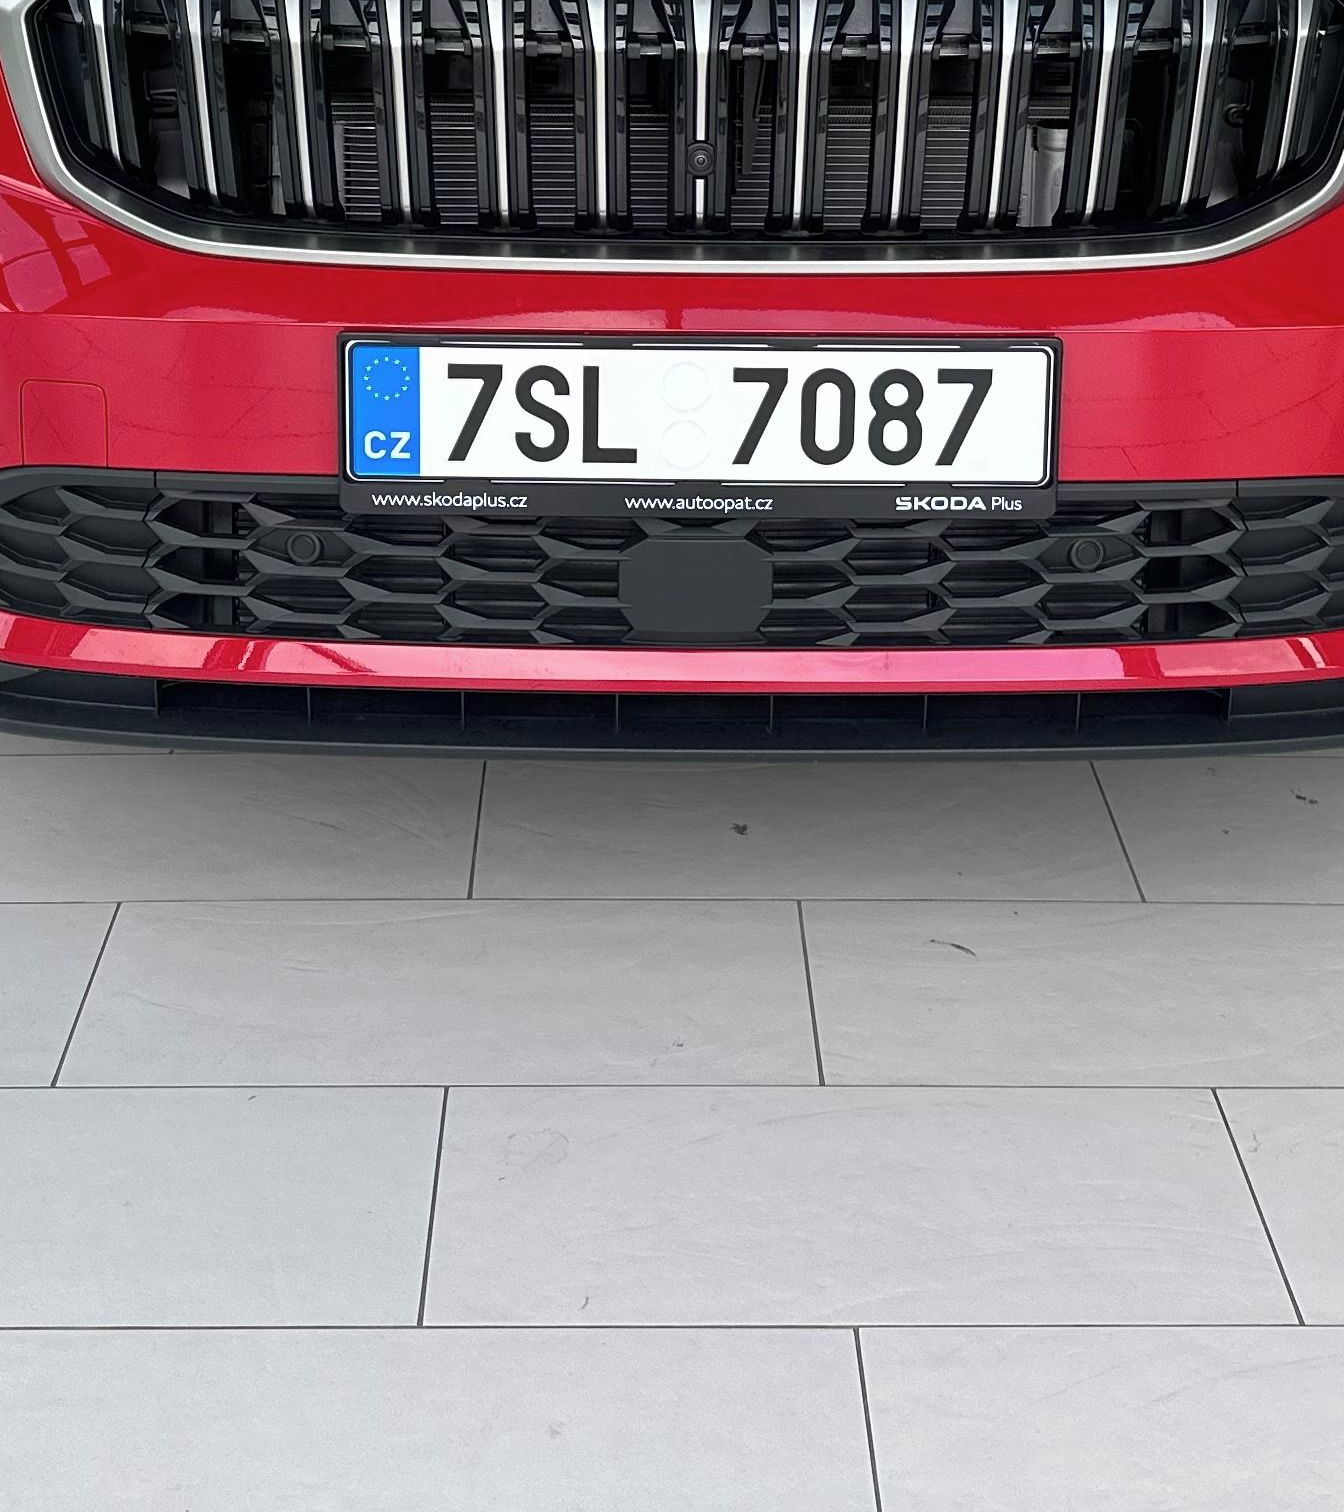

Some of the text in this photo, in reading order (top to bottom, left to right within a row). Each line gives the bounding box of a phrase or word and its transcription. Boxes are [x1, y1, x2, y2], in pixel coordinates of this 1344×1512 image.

[446, 363, 994, 466] 7SL 7087
[364, 430, 411, 460] CZ
[371, 492, 528, 511] www.skodaplus.cz
[624, 495, 774, 514] www.autoopat.cz
[991, 496, 1023, 511] Plus
